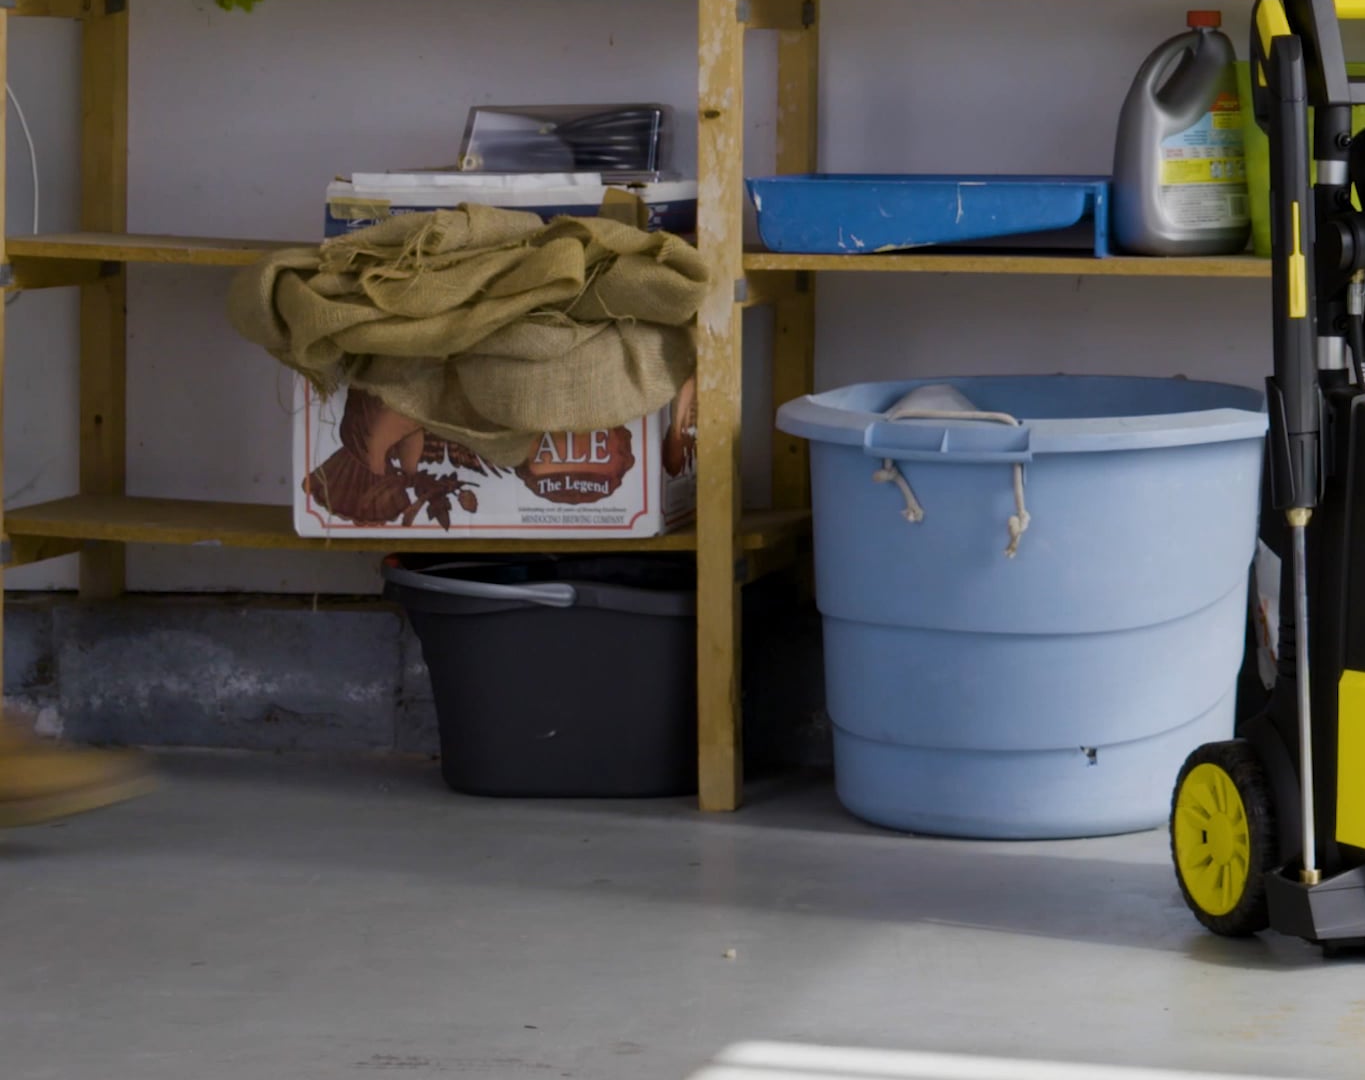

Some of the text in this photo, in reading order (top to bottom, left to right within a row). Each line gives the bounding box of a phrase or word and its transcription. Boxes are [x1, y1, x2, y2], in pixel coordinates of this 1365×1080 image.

[534, 428, 612, 464] ALE
[538, 475, 609, 495] The Legend
